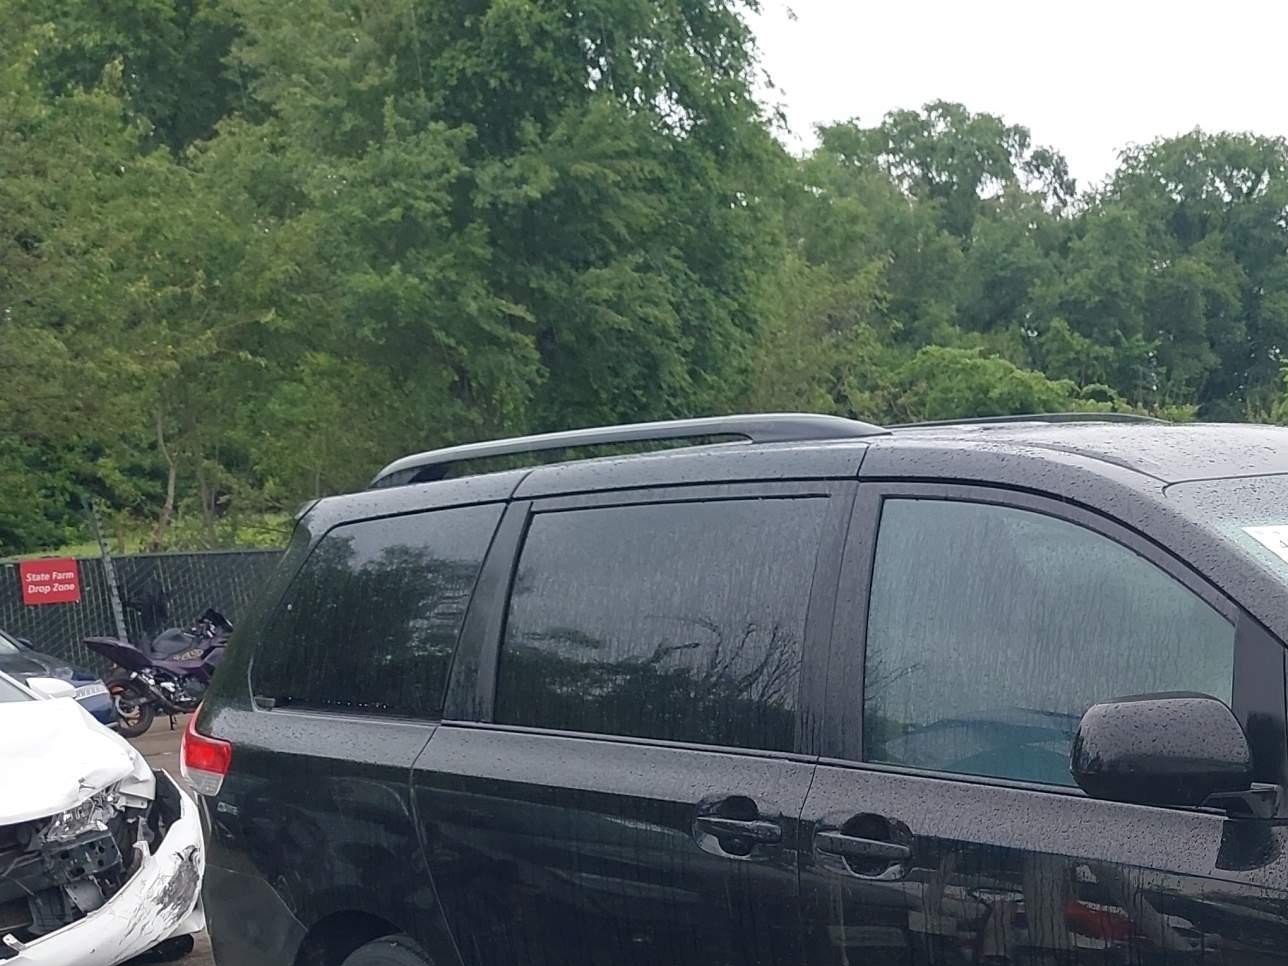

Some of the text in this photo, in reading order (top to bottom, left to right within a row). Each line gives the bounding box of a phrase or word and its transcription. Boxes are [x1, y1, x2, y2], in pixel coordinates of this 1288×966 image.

[26, 572, 74, 582] State Farm
[28, 583, 75, 594] Drop Zone
